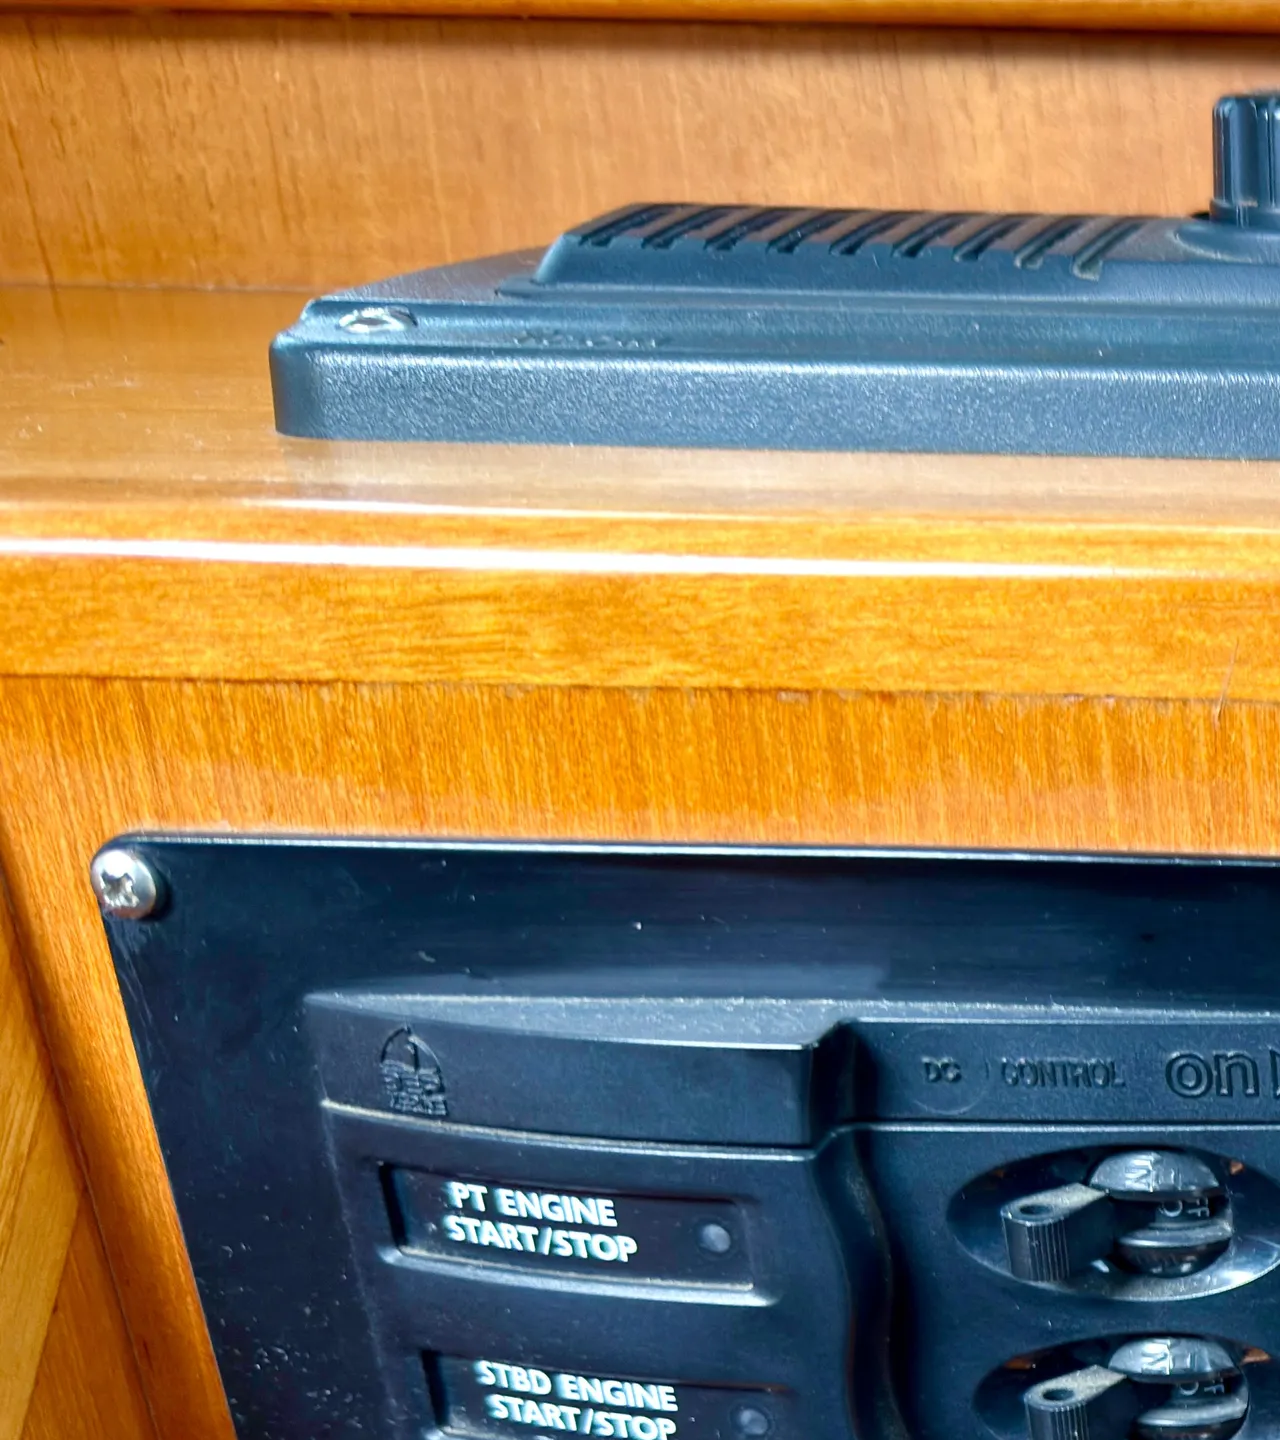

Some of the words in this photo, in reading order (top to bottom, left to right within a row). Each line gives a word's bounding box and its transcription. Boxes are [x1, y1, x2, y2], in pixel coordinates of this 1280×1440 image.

[922, 1056, 963, 1083] DC
[1001, 1056, 1126, 1088] CONTROL
[448, 1181, 488, 1212] PT
[495, 1188, 617, 1227] ENGINE
[443, 1215, 638, 1262] START/STOP
[474, 1360, 552, 1395] STBD
[555, 1373, 679, 1412] ENGINE
